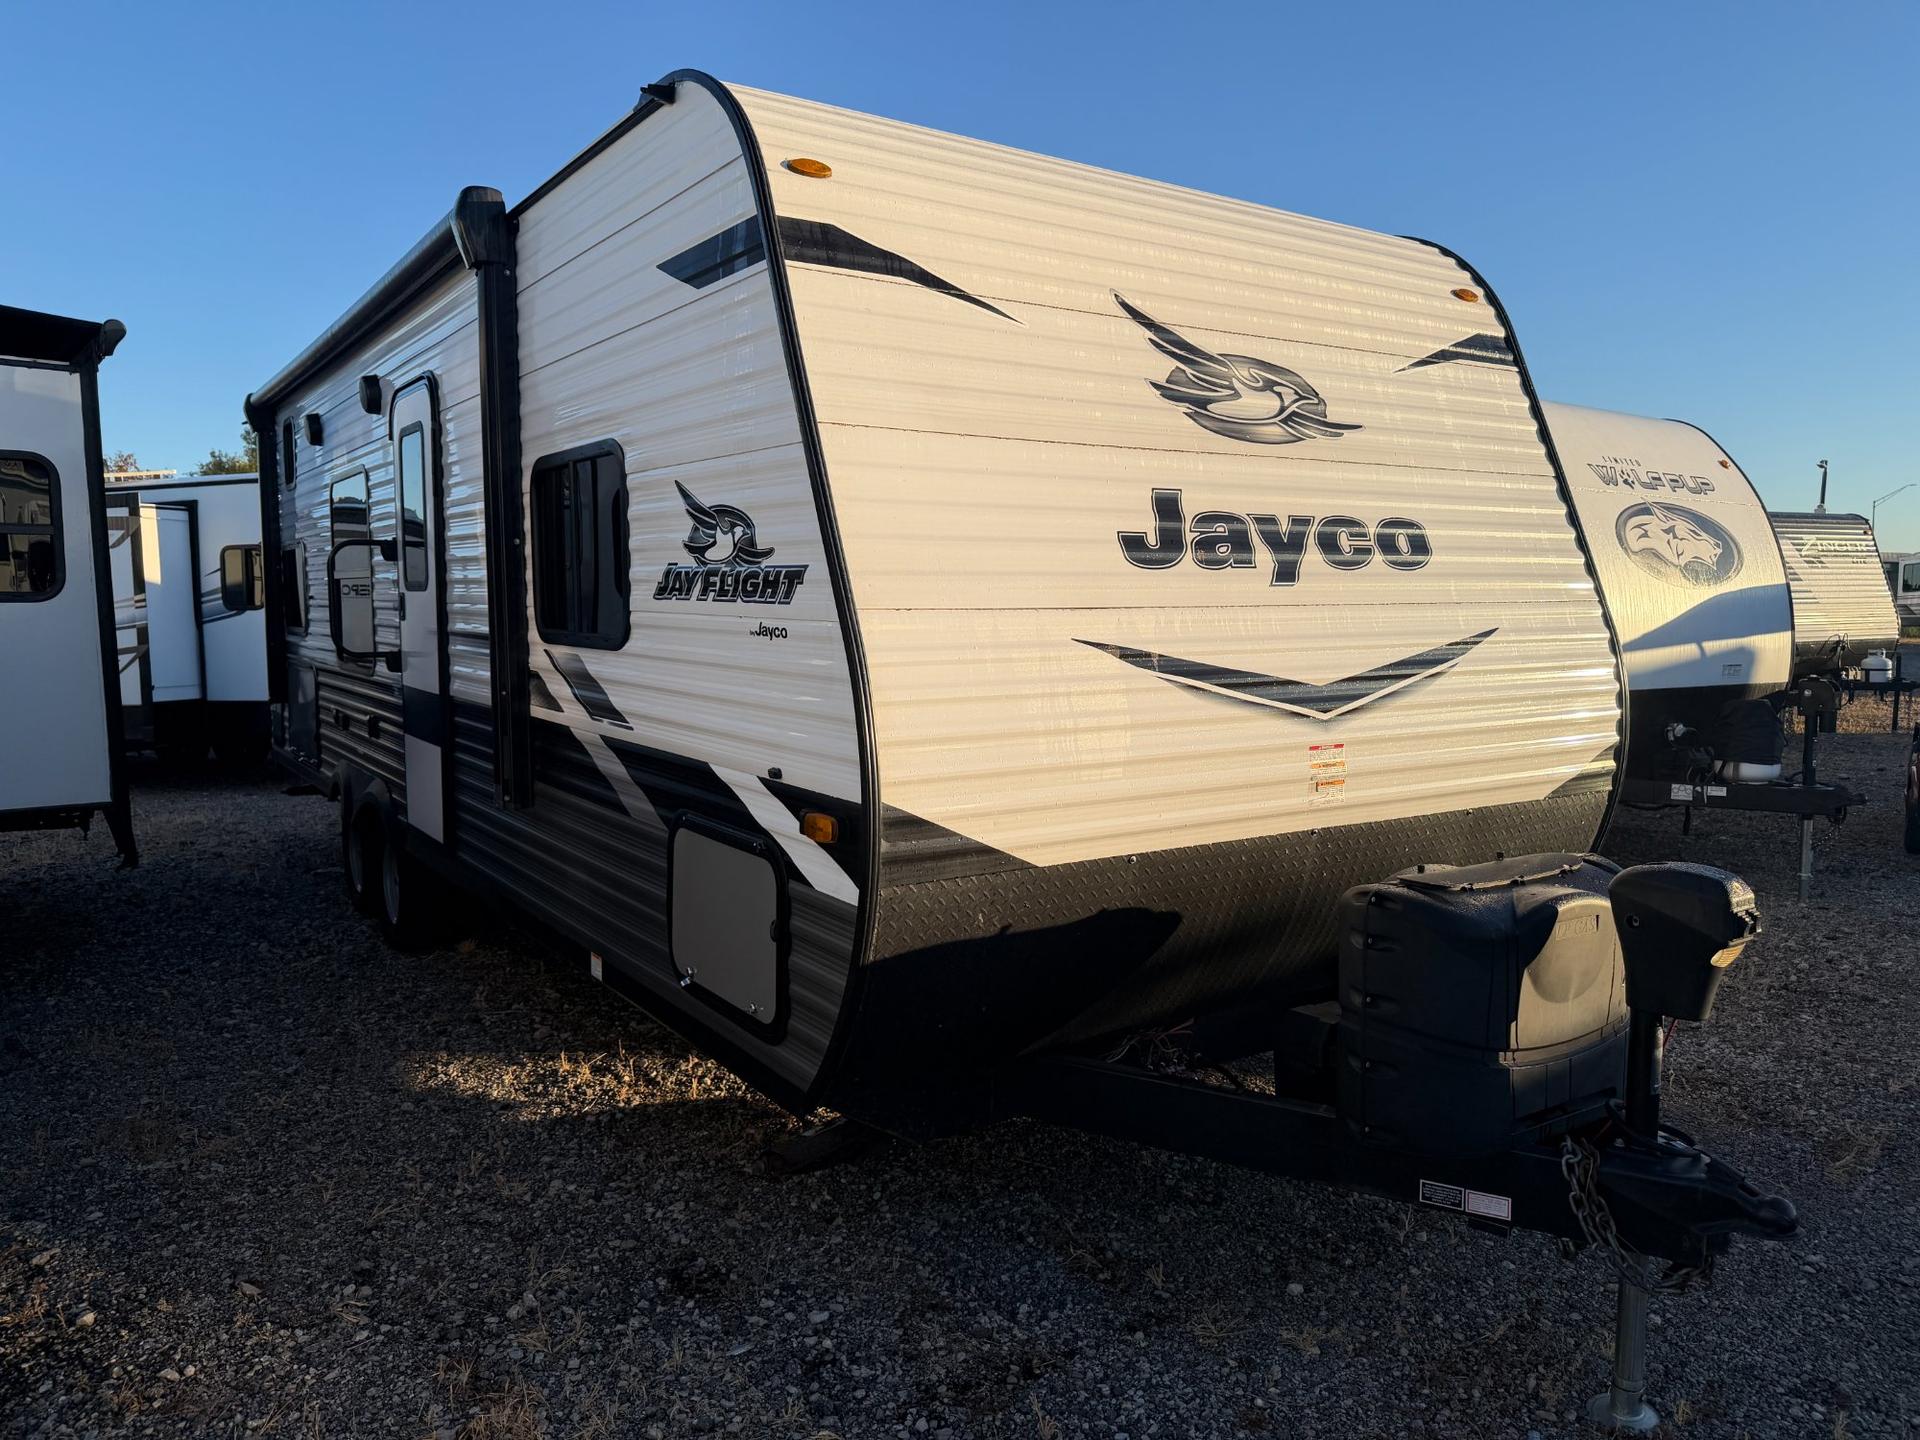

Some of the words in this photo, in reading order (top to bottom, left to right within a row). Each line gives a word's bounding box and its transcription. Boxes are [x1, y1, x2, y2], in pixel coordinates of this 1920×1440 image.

[1117, 488, 1433, 587] Jayco
[653, 562, 700, 601] JAY
[696, 564, 809, 605] FLIGHT
[755, 621, 788, 641] Jayco
